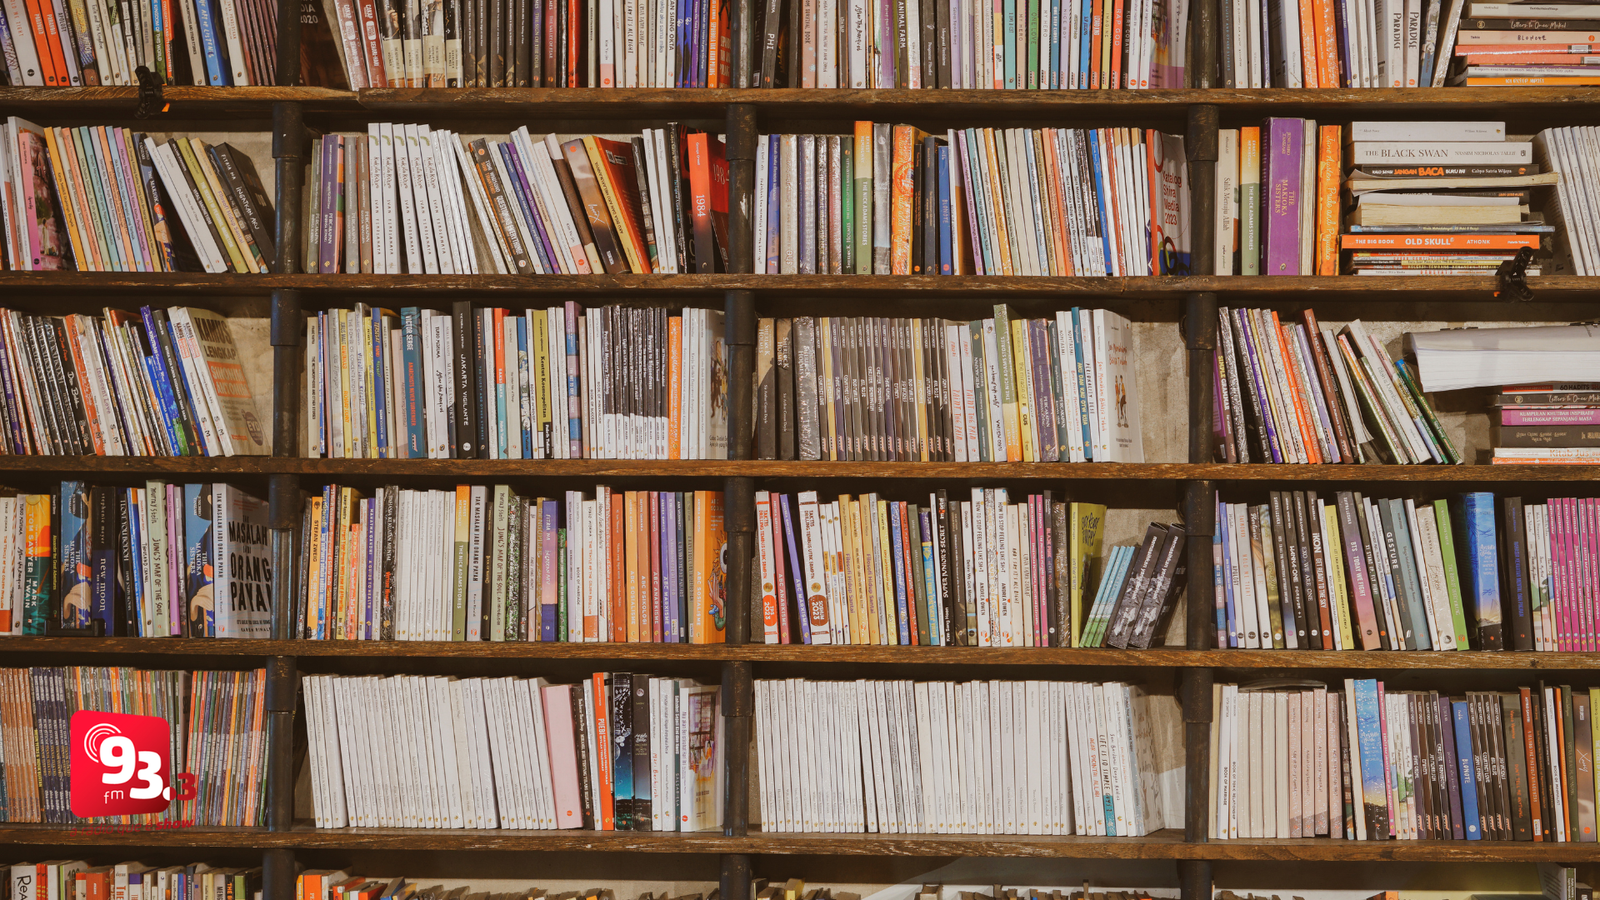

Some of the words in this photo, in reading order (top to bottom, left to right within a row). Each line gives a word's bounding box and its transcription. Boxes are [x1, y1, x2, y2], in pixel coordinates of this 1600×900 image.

[766, 33, 775, 50] PHI
[1394, 13, 1402, 50] PARADISE
[1409, 12, 1419, 49] PARADISE
[1381, 149, 1415, 158] BLACK
[1418, 149, 1448, 158] SWAN
[1418, 167, 1444, 176] BACA
[695, 194, 706, 217] 1984
[1164, 213, 1177, 225] 2023
[194, 317, 232, 345] KAMUS
[1217, 356, 1226, 378] SIMPLE
[1220, 379, 1230, 410] GRAMMAR
[103, 399, 112, 415] Love
[228, 521, 268, 546] MASALAH
[1312, 533, 1322, 553] iKON
[152, 538, 161, 561] JUNG'S
[1386, 532, 1399, 570] GESTURE
[230, 552, 271, 582] ORANG
[1352, 556, 1361, 573] TODAY
[154, 579, 161, 588] OF
[1355, 573, 1362, 581] WE
[98, 583, 107, 612] moon
[1356, 581, 1366, 597] FIGHT
[798, 594, 808, 627] MARXISME
[1462, 759, 1470, 784] BLONOTE
